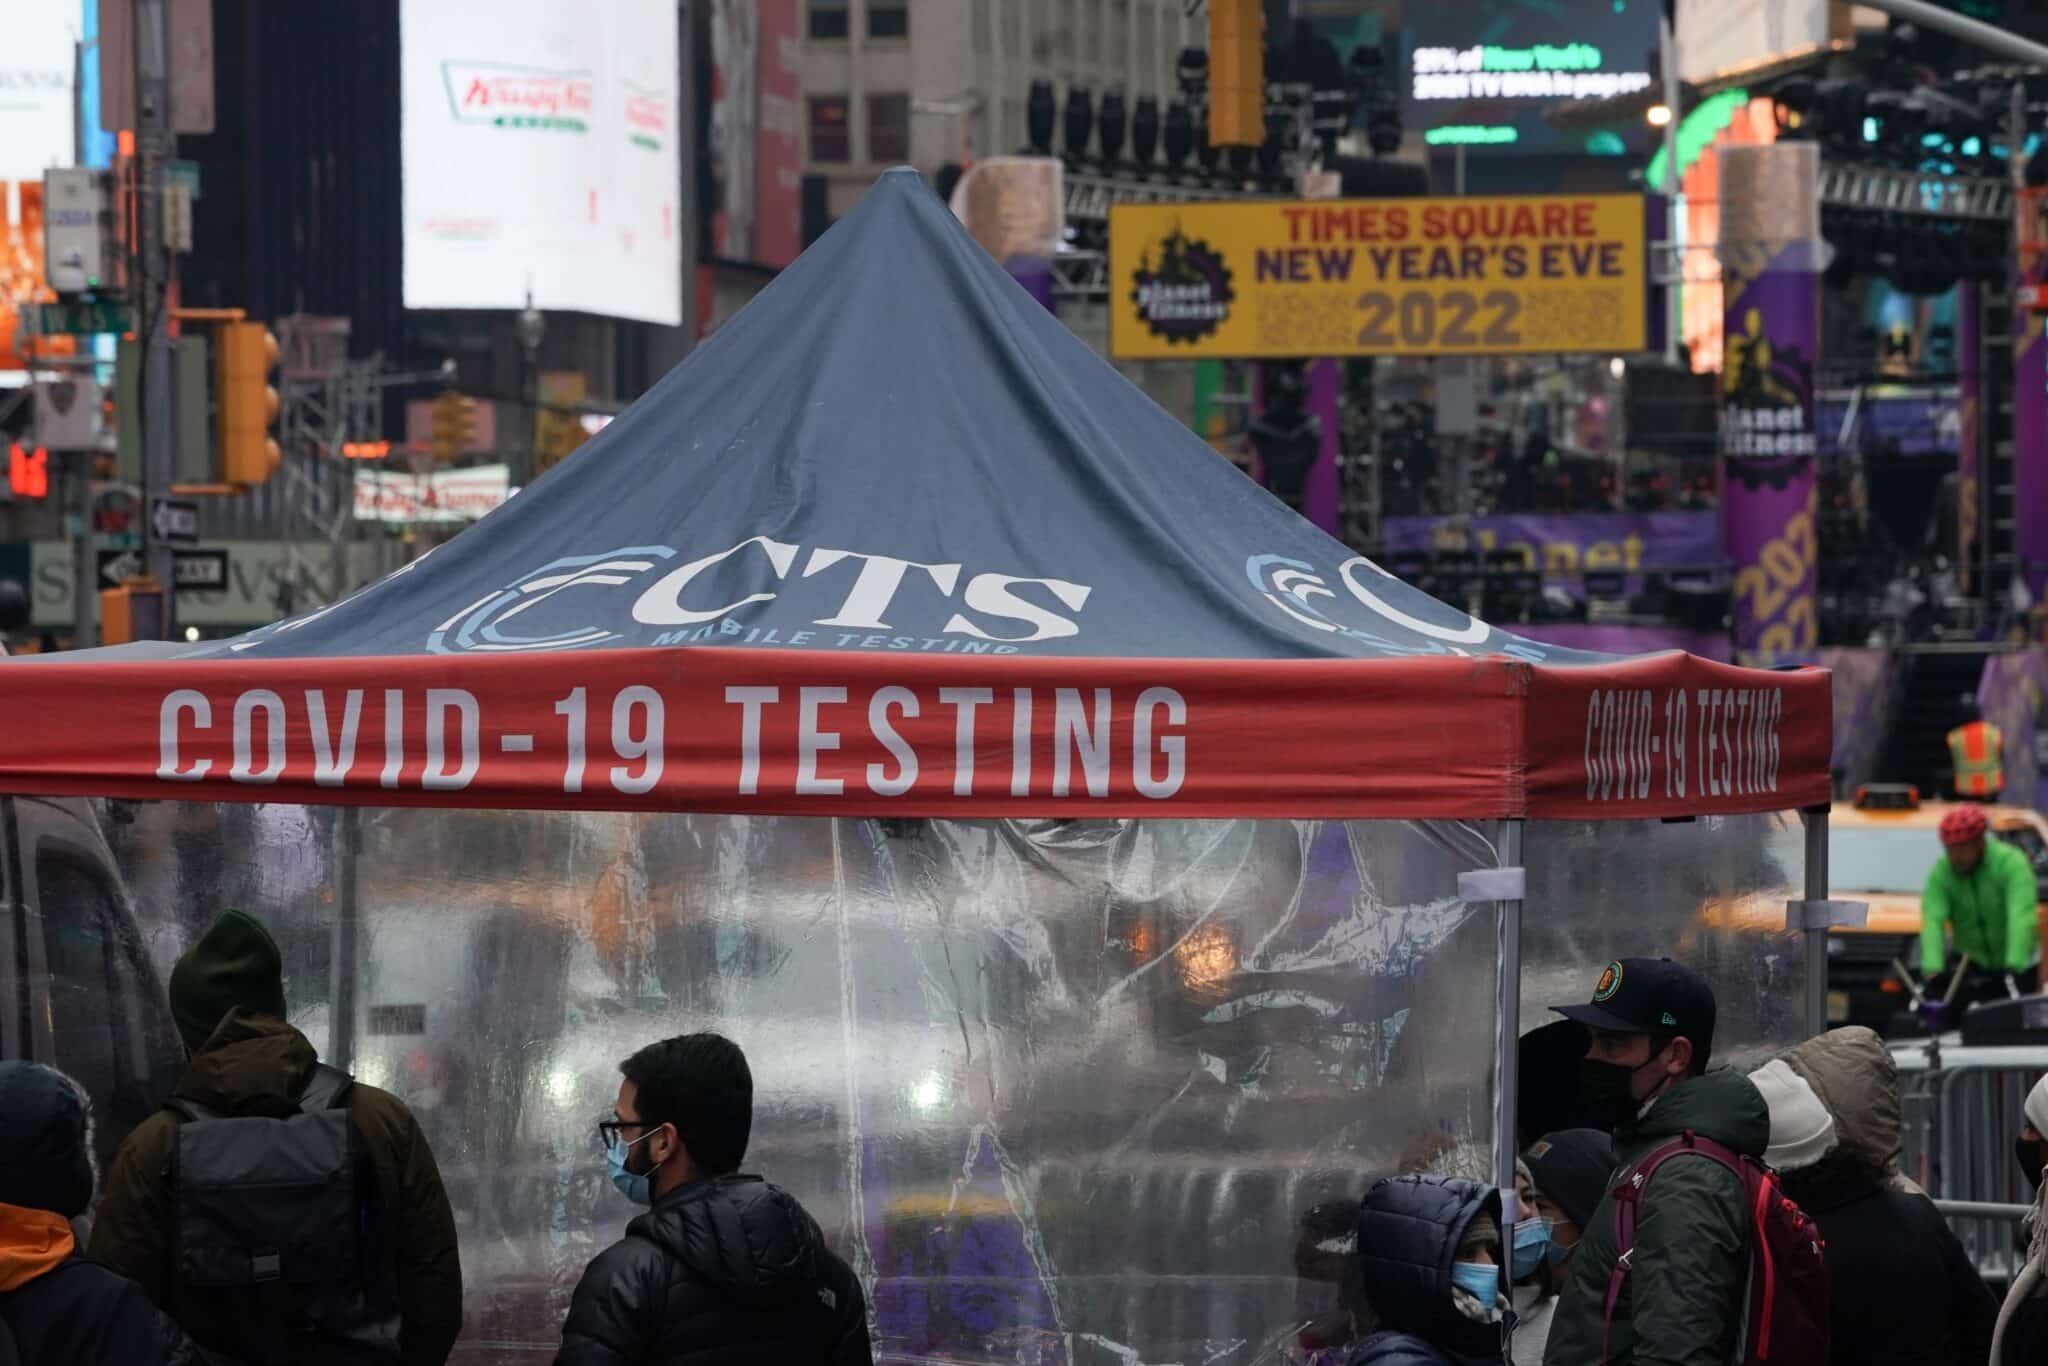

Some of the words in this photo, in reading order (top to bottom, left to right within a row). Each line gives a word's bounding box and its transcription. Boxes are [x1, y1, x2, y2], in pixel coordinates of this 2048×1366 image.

[1283, 205, 1409, 242] TIMES
[1421, 203, 1597, 240] SQUARE
[1256, 247, 1355, 283] NEW
[1366, 244, 1528, 281] YEAR'S
[1539, 241, 1623, 278] EVE
[1138, 279, 1211, 305] planet
[1356, 287, 1522, 347] 2022
[631, 535, 1093, 642] CTS
[835, 633, 1019, 655] TESTING
[155, 685, 666, 795] COVID-19
[724, 685, 1188, 800] TESTING
[1584, 688, 1688, 801] COVID-19
[1697, 687, 1782, 797] TESTING
